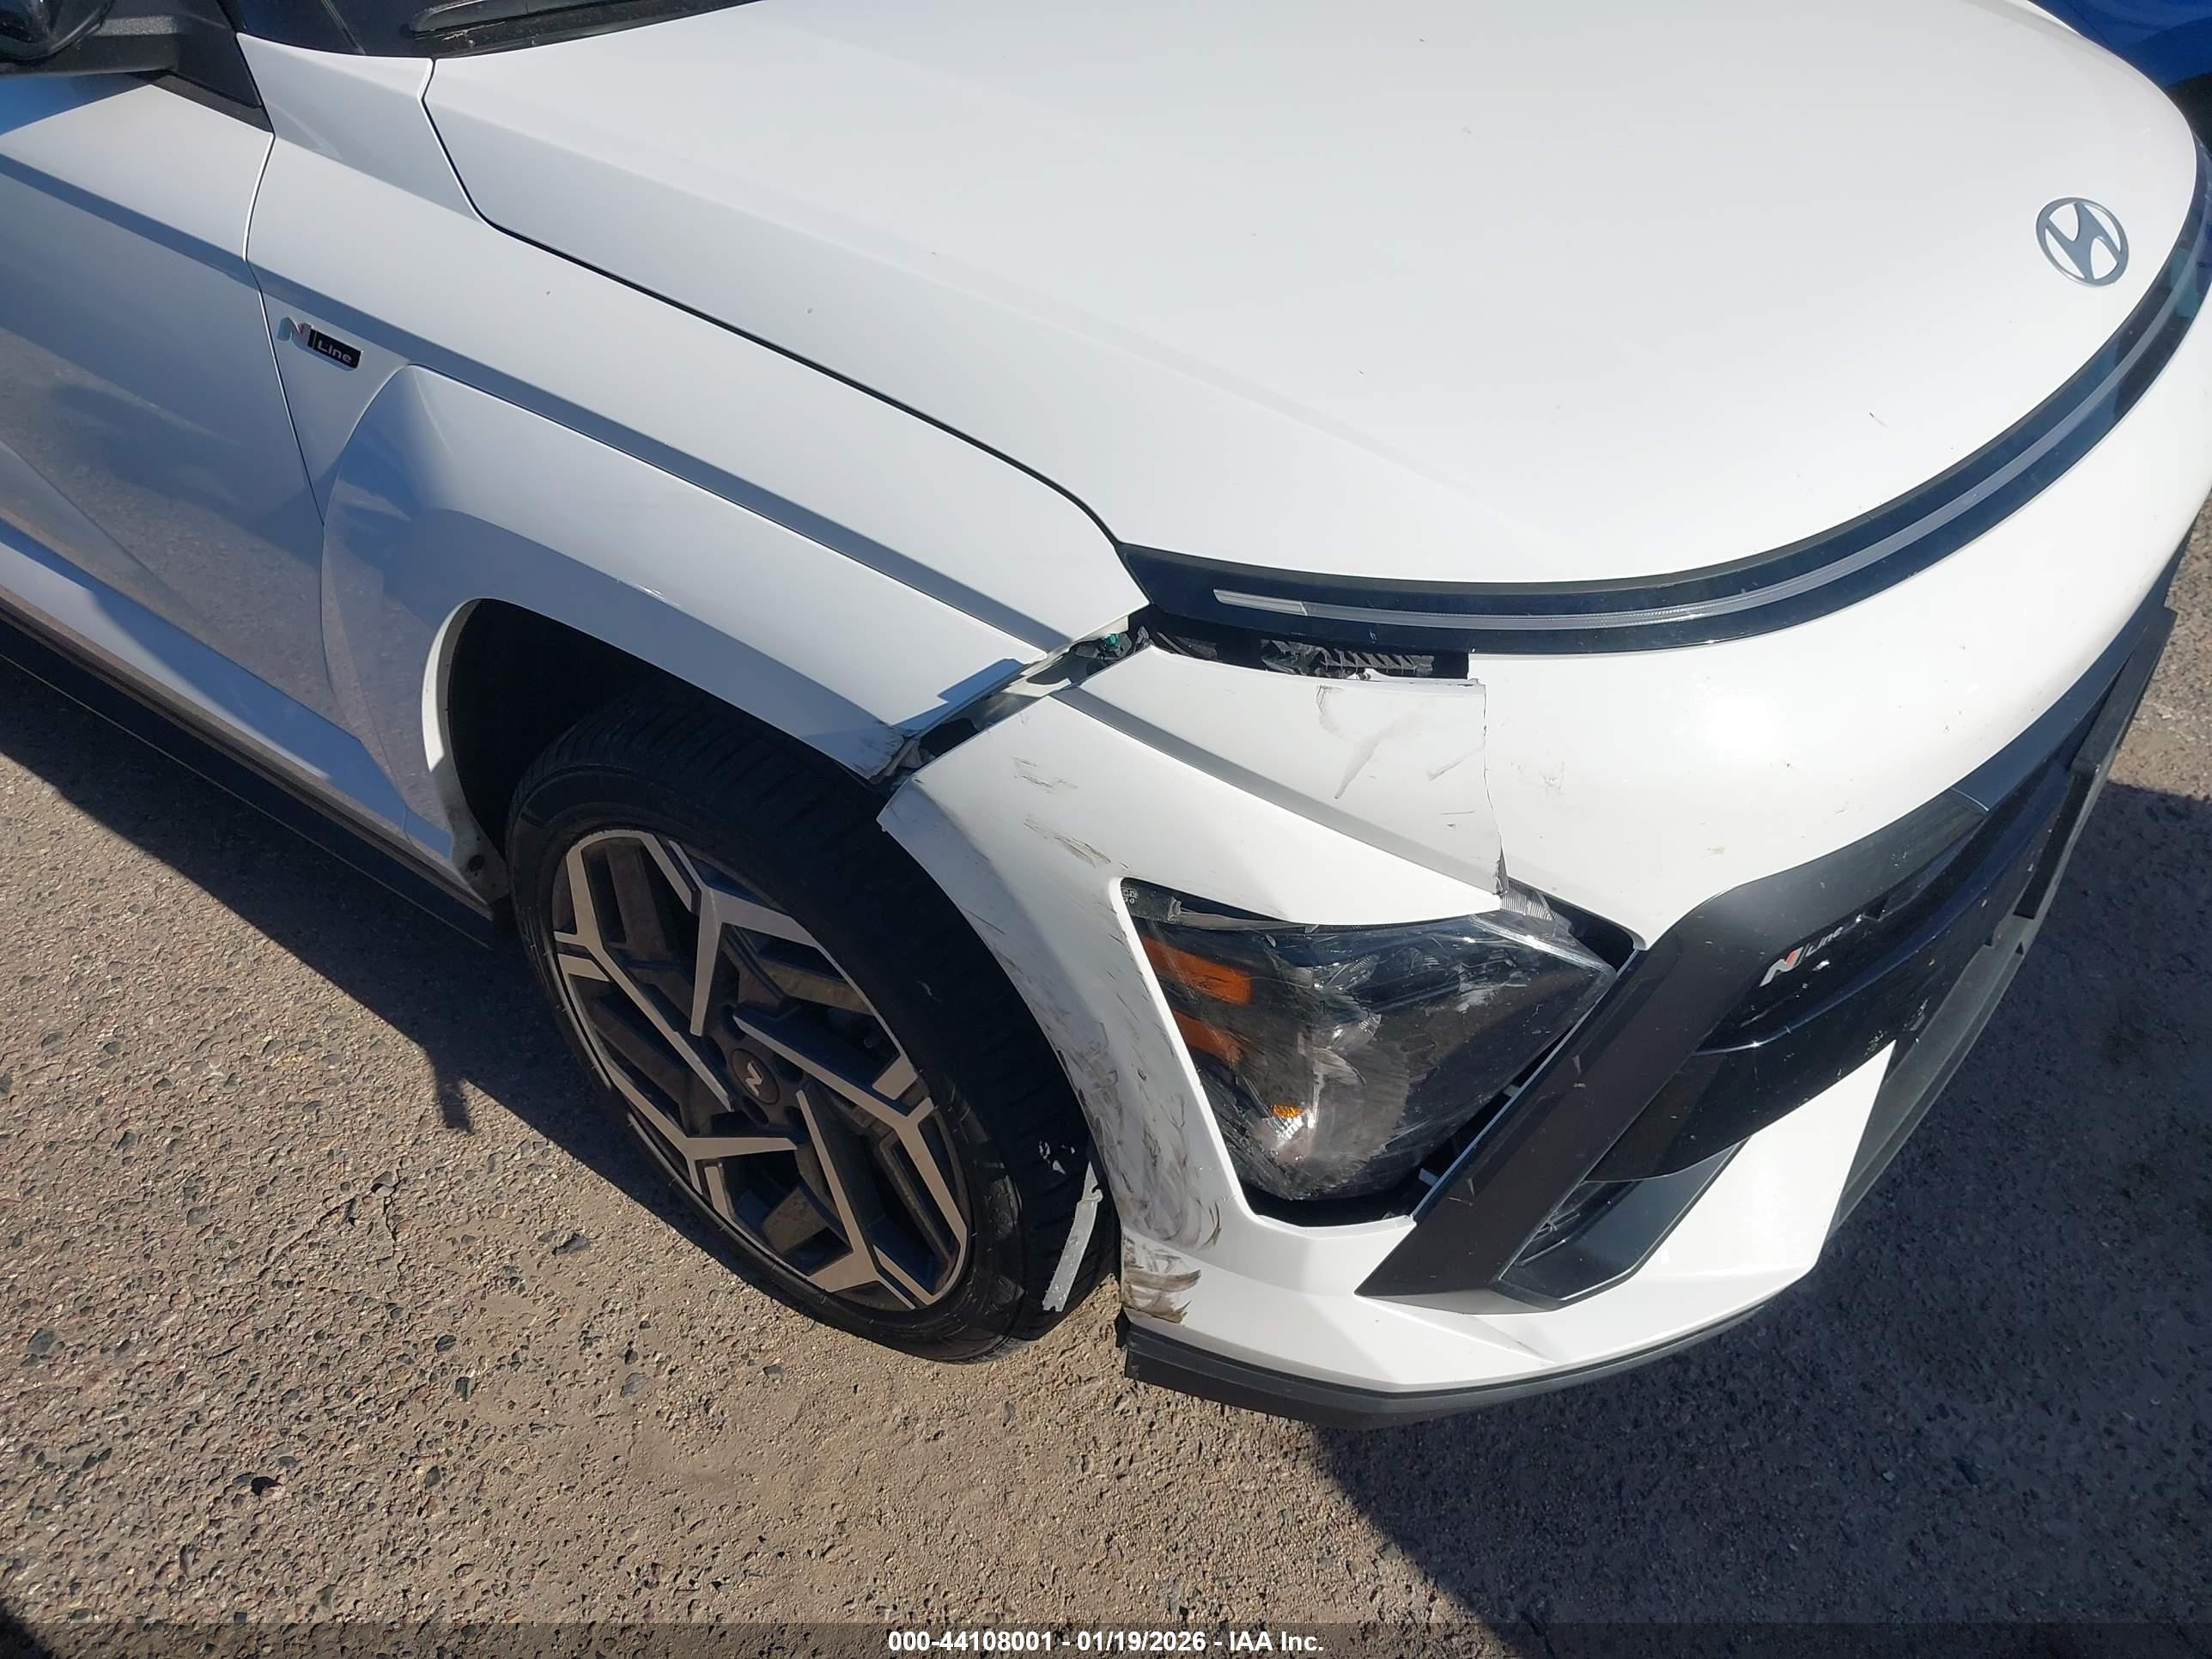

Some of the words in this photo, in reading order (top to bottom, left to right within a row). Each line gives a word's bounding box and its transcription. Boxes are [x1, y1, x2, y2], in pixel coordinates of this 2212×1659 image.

[276, 317, 311, 349] N
[318, 339, 352, 364] Line
[1759, 945, 1804, 988] N
[1806, 926, 1845, 958] Line
